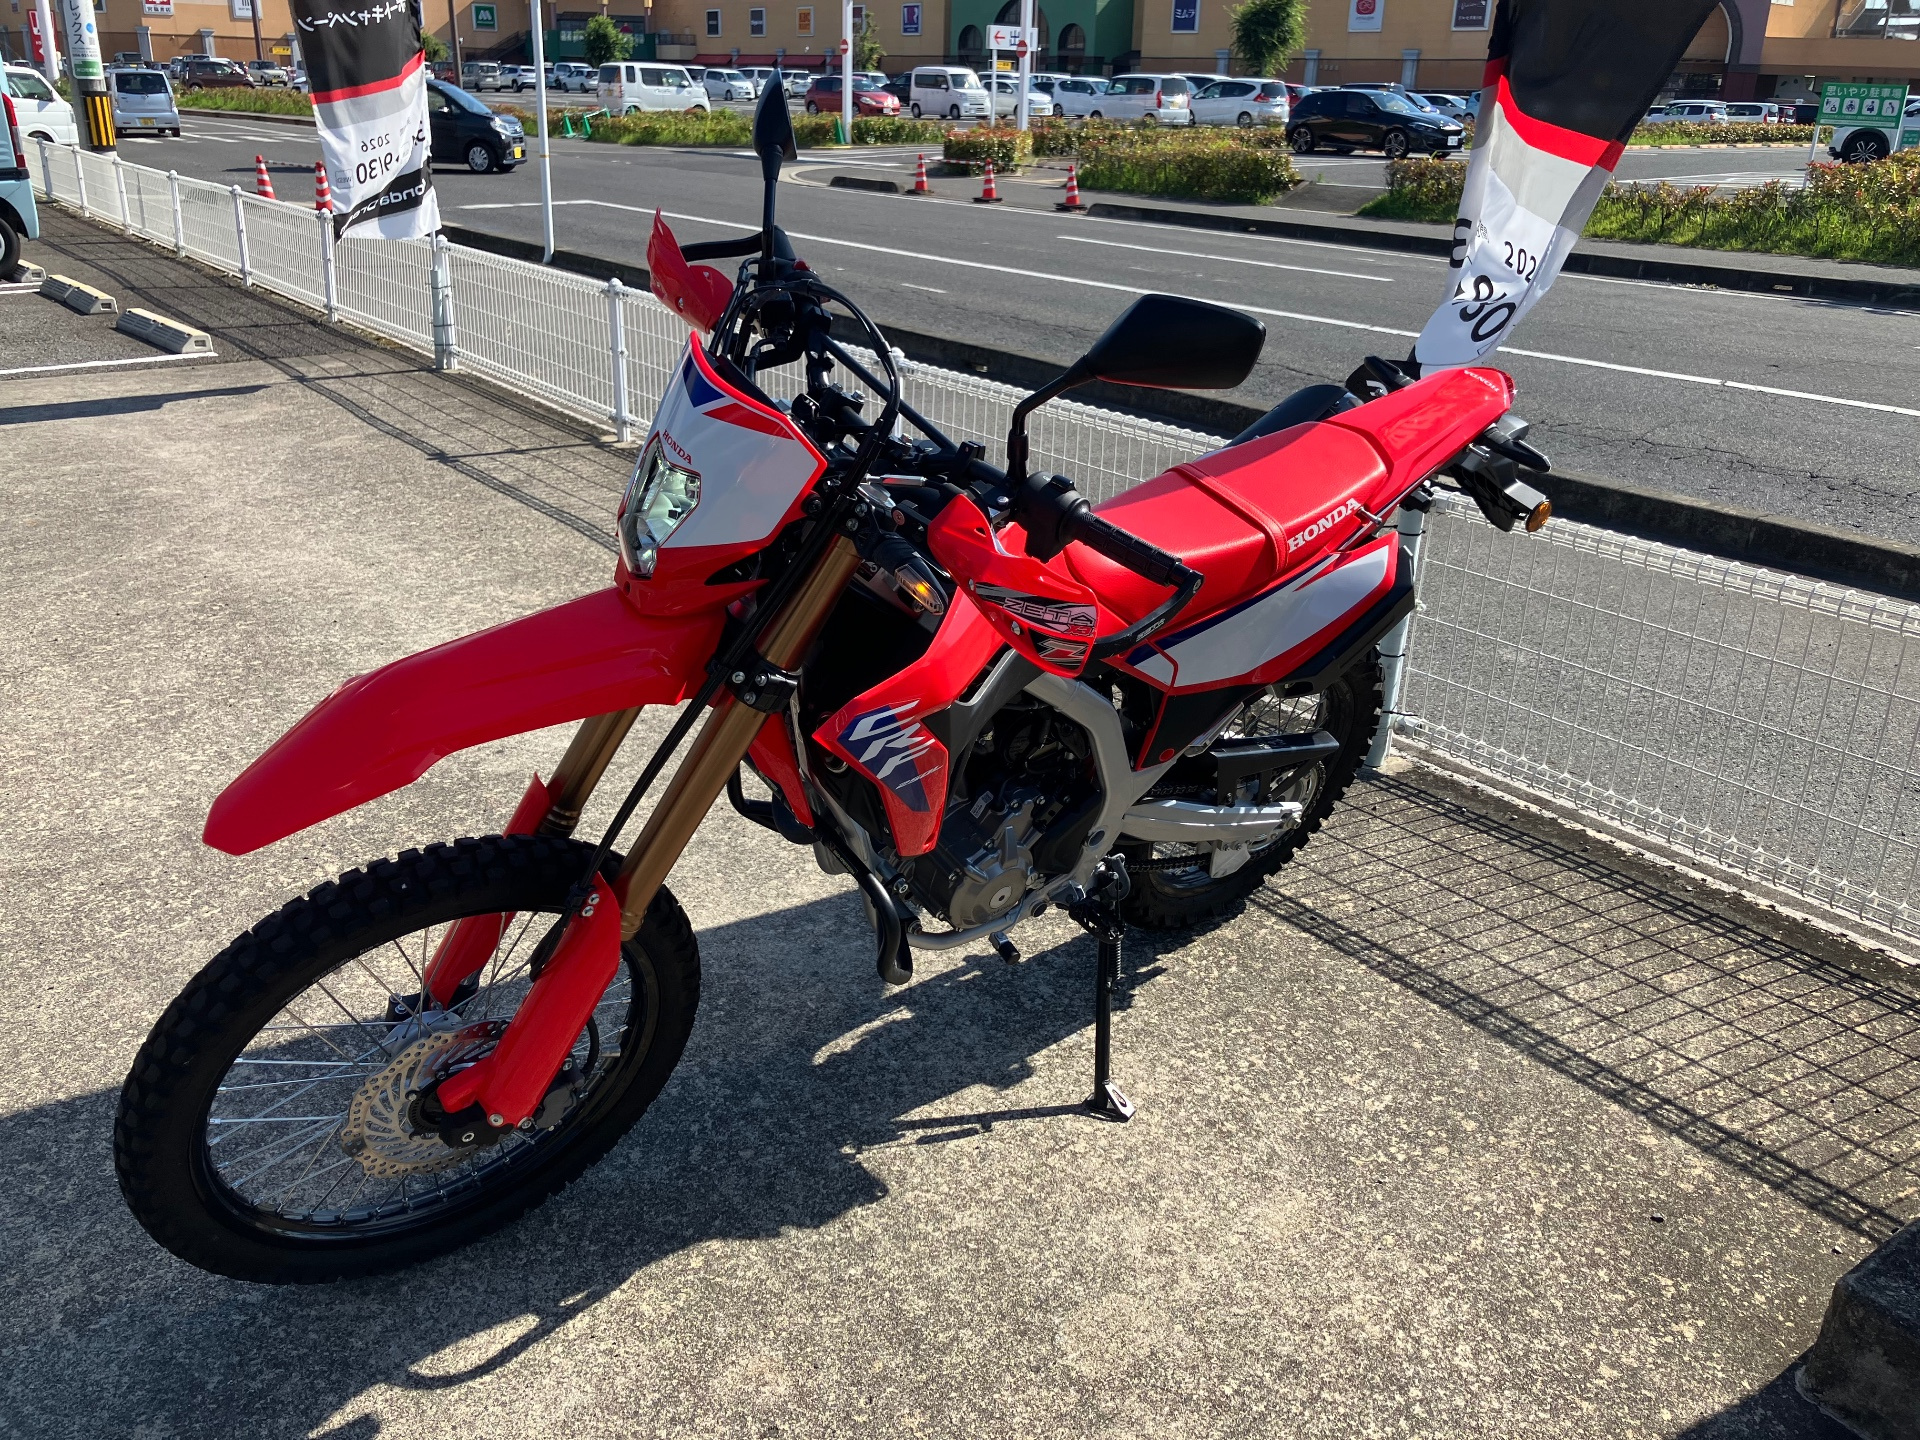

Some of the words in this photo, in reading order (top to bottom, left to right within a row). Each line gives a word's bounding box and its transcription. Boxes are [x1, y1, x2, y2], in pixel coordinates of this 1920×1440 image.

[1825, 85, 1903, 99] 思いやり駐車場
[1504, 241, 1537, 283] 202
[1463, 369, 1499, 393] HONDA
[662, 429, 692, 465] HONDA
[1287, 498, 1361, 553] HONDA
[1002, 597, 1096, 627] ZETA
